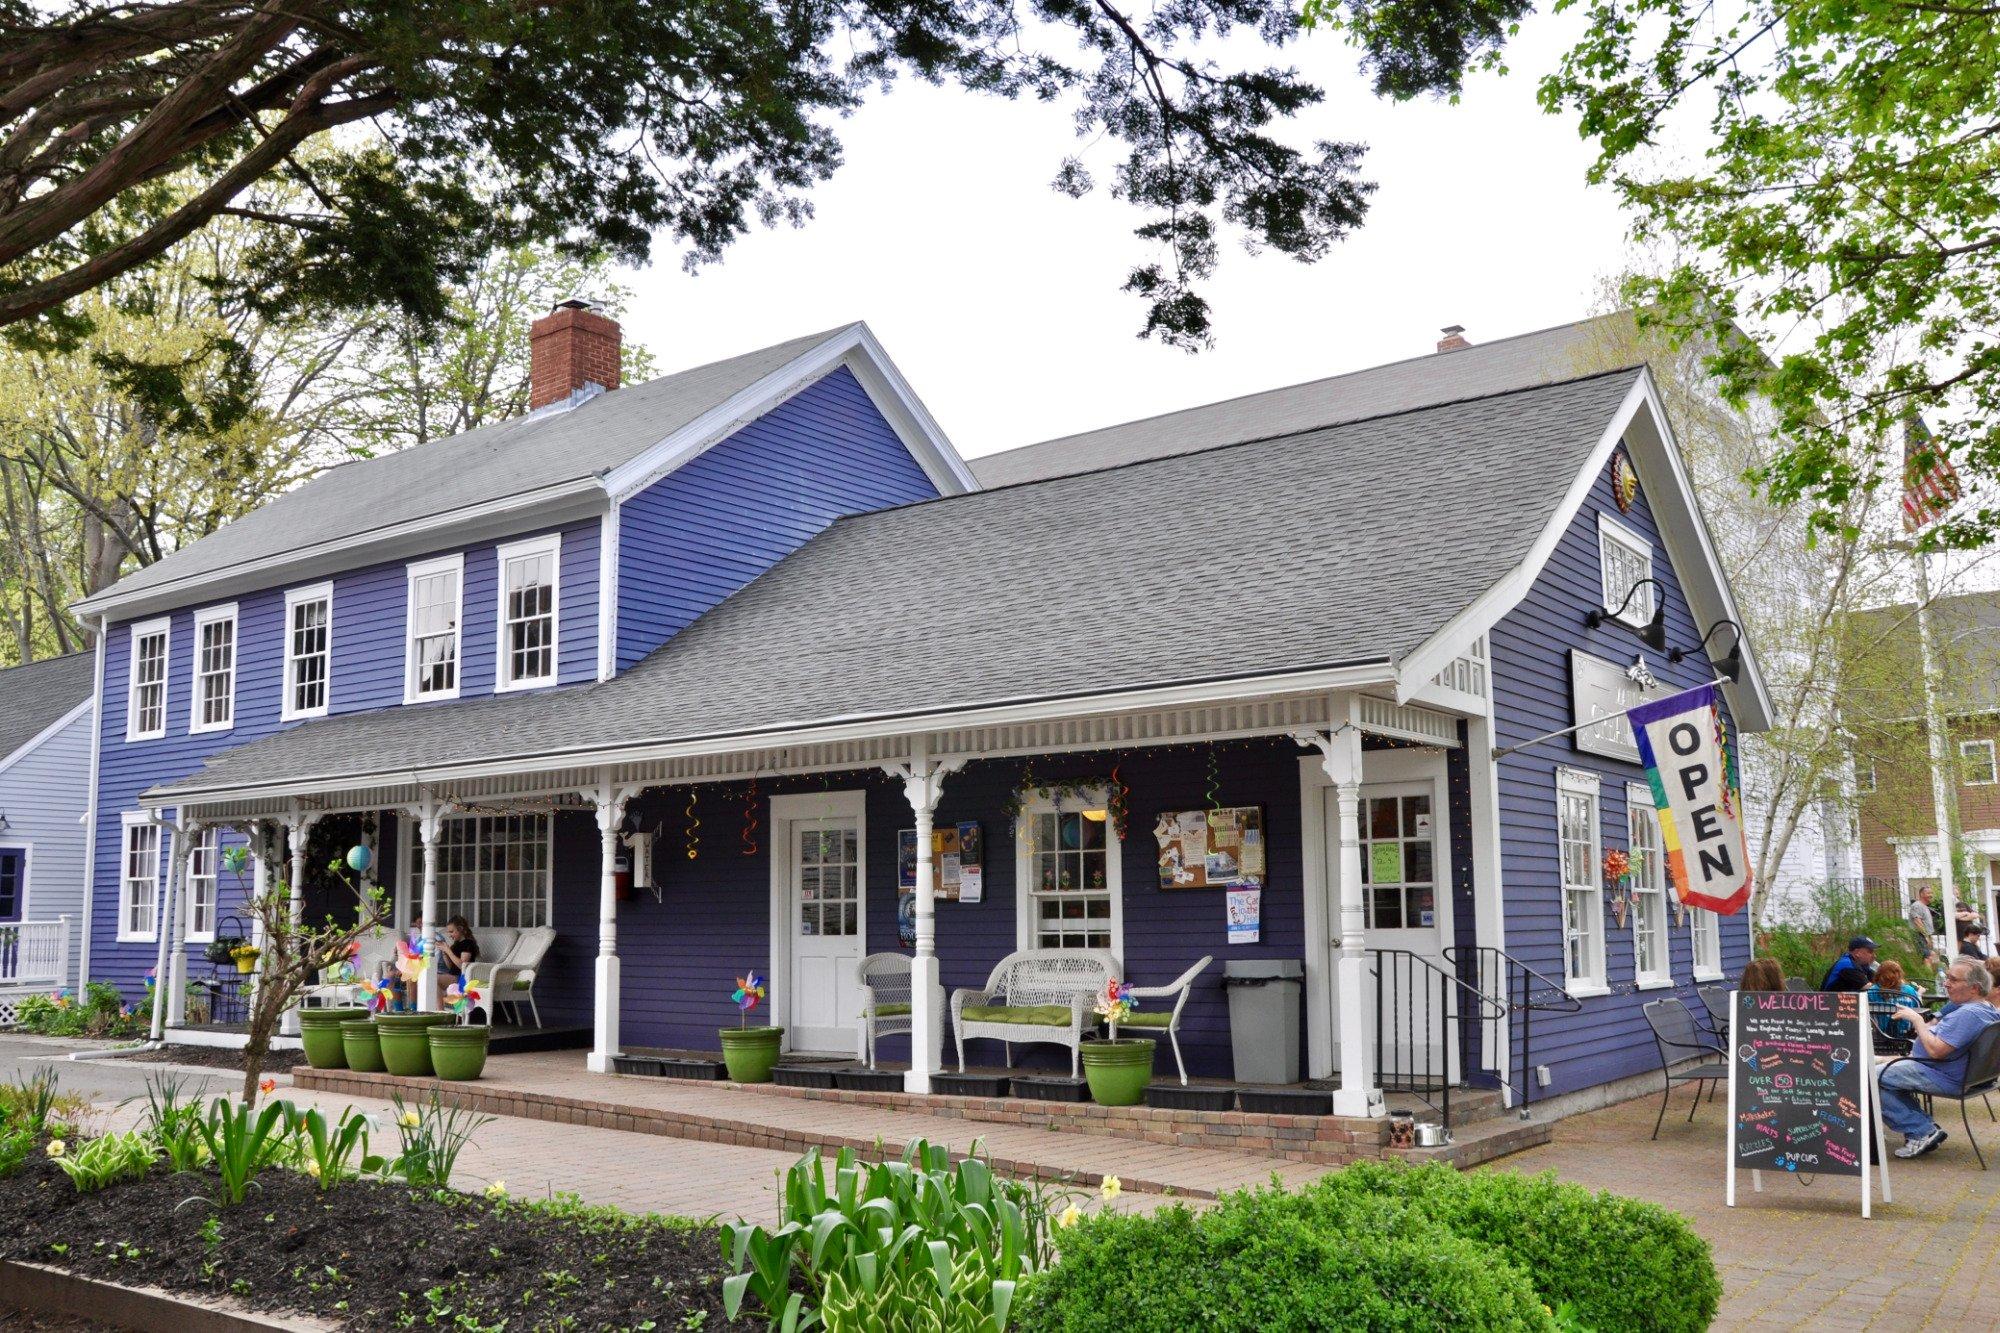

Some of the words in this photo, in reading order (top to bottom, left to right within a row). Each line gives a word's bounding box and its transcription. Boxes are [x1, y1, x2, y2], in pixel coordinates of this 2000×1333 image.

[1668, 722, 1735, 882] OPEN
[1758, 994, 1830, 1010] WELCOME
[1749, 1076, 1772, 1085] OVER
[1795, 1077, 1836, 1087] FLAVORS
[1740, 1110, 1776, 1122] Milkshakes
[1820, 1110, 1847, 1128] FLOATS
[1756, 1123, 1779, 1138] MALTS
